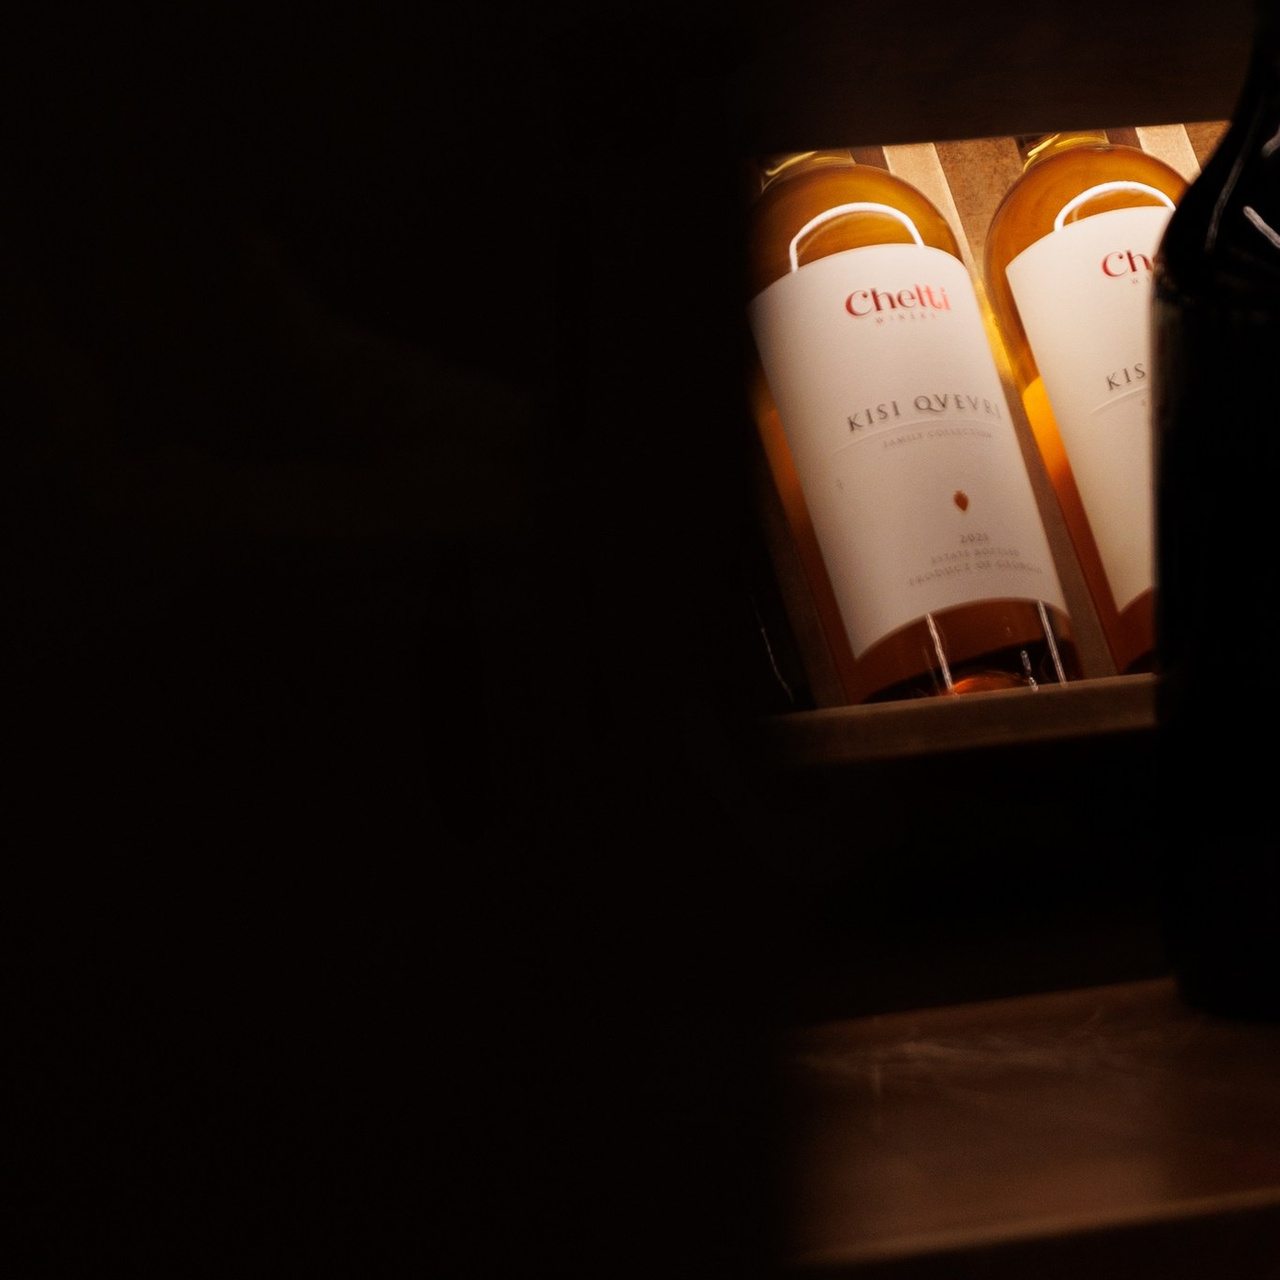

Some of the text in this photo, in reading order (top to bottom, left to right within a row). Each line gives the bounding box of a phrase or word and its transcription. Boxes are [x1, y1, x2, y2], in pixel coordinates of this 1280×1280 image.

[1106, 362, 1146, 392] KIS
[848, 393, 1003, 432] KISI QVEVRI
